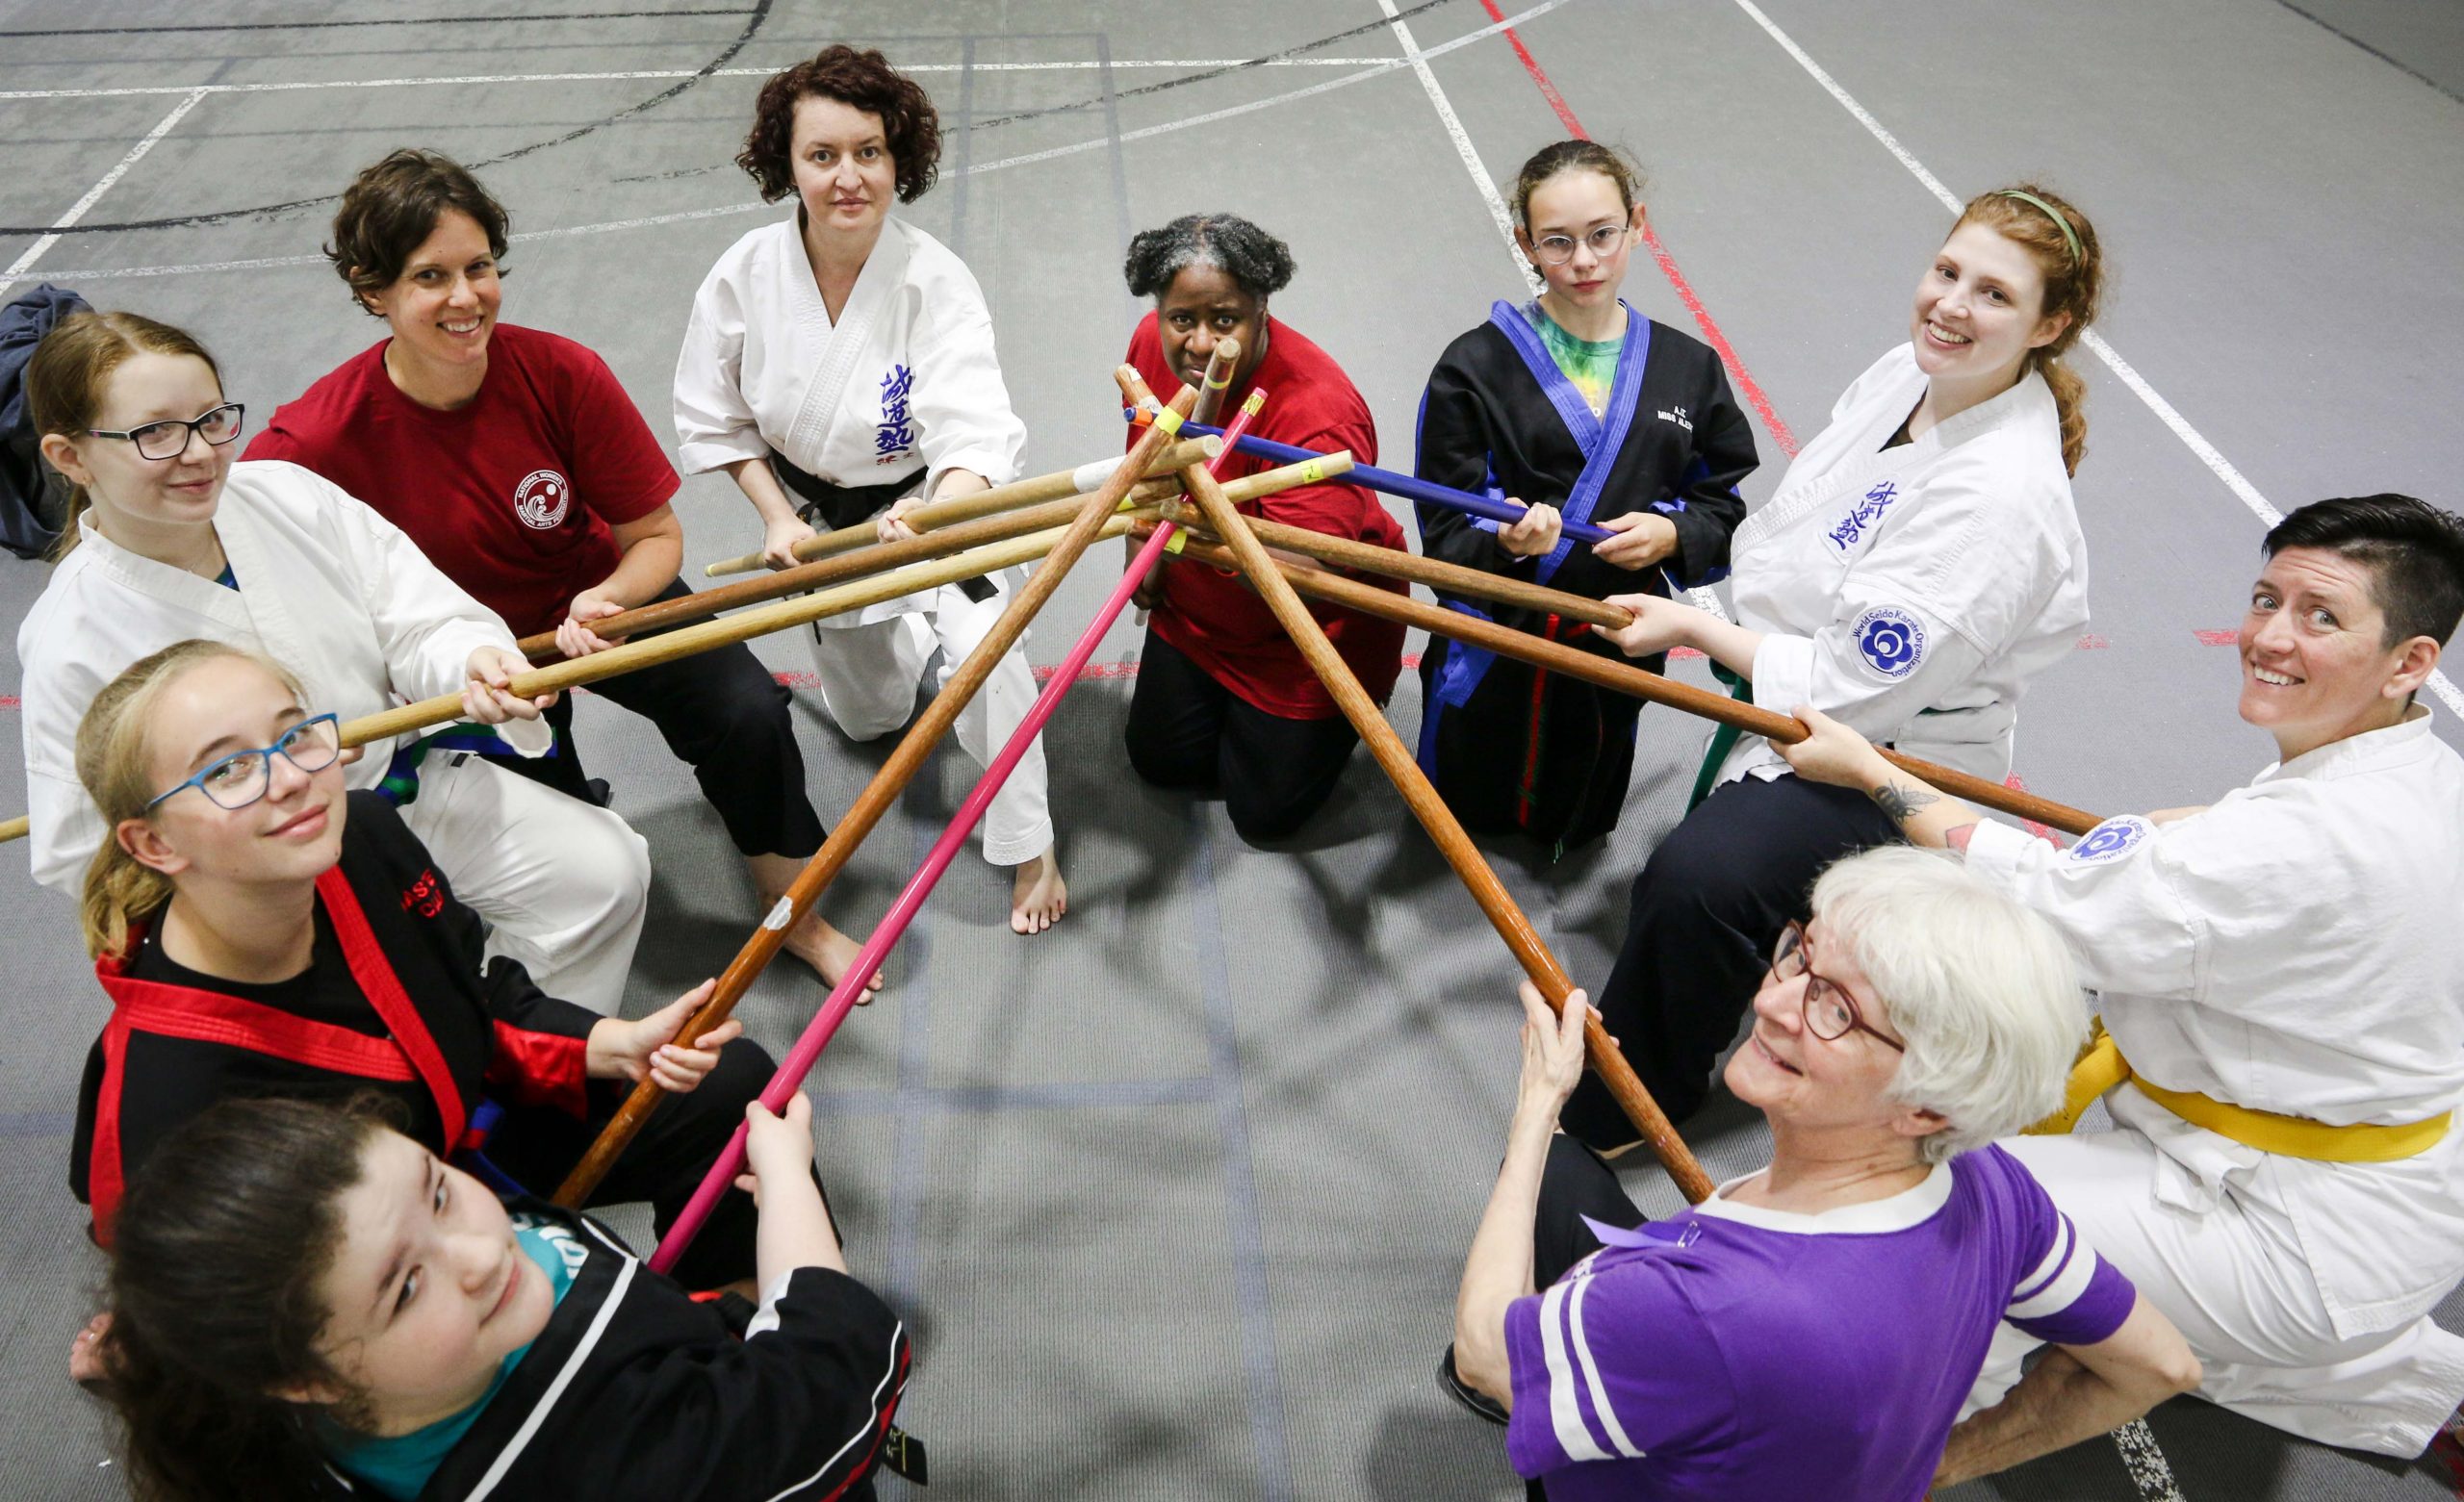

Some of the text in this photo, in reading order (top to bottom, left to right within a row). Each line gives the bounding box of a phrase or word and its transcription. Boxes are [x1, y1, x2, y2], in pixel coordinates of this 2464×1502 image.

[518, 474, 539, 497] NATIONAL
[518, 505, 536, 525] MARTIAL
[1852, 609, 1924, 676] World Seido Karate Organization
